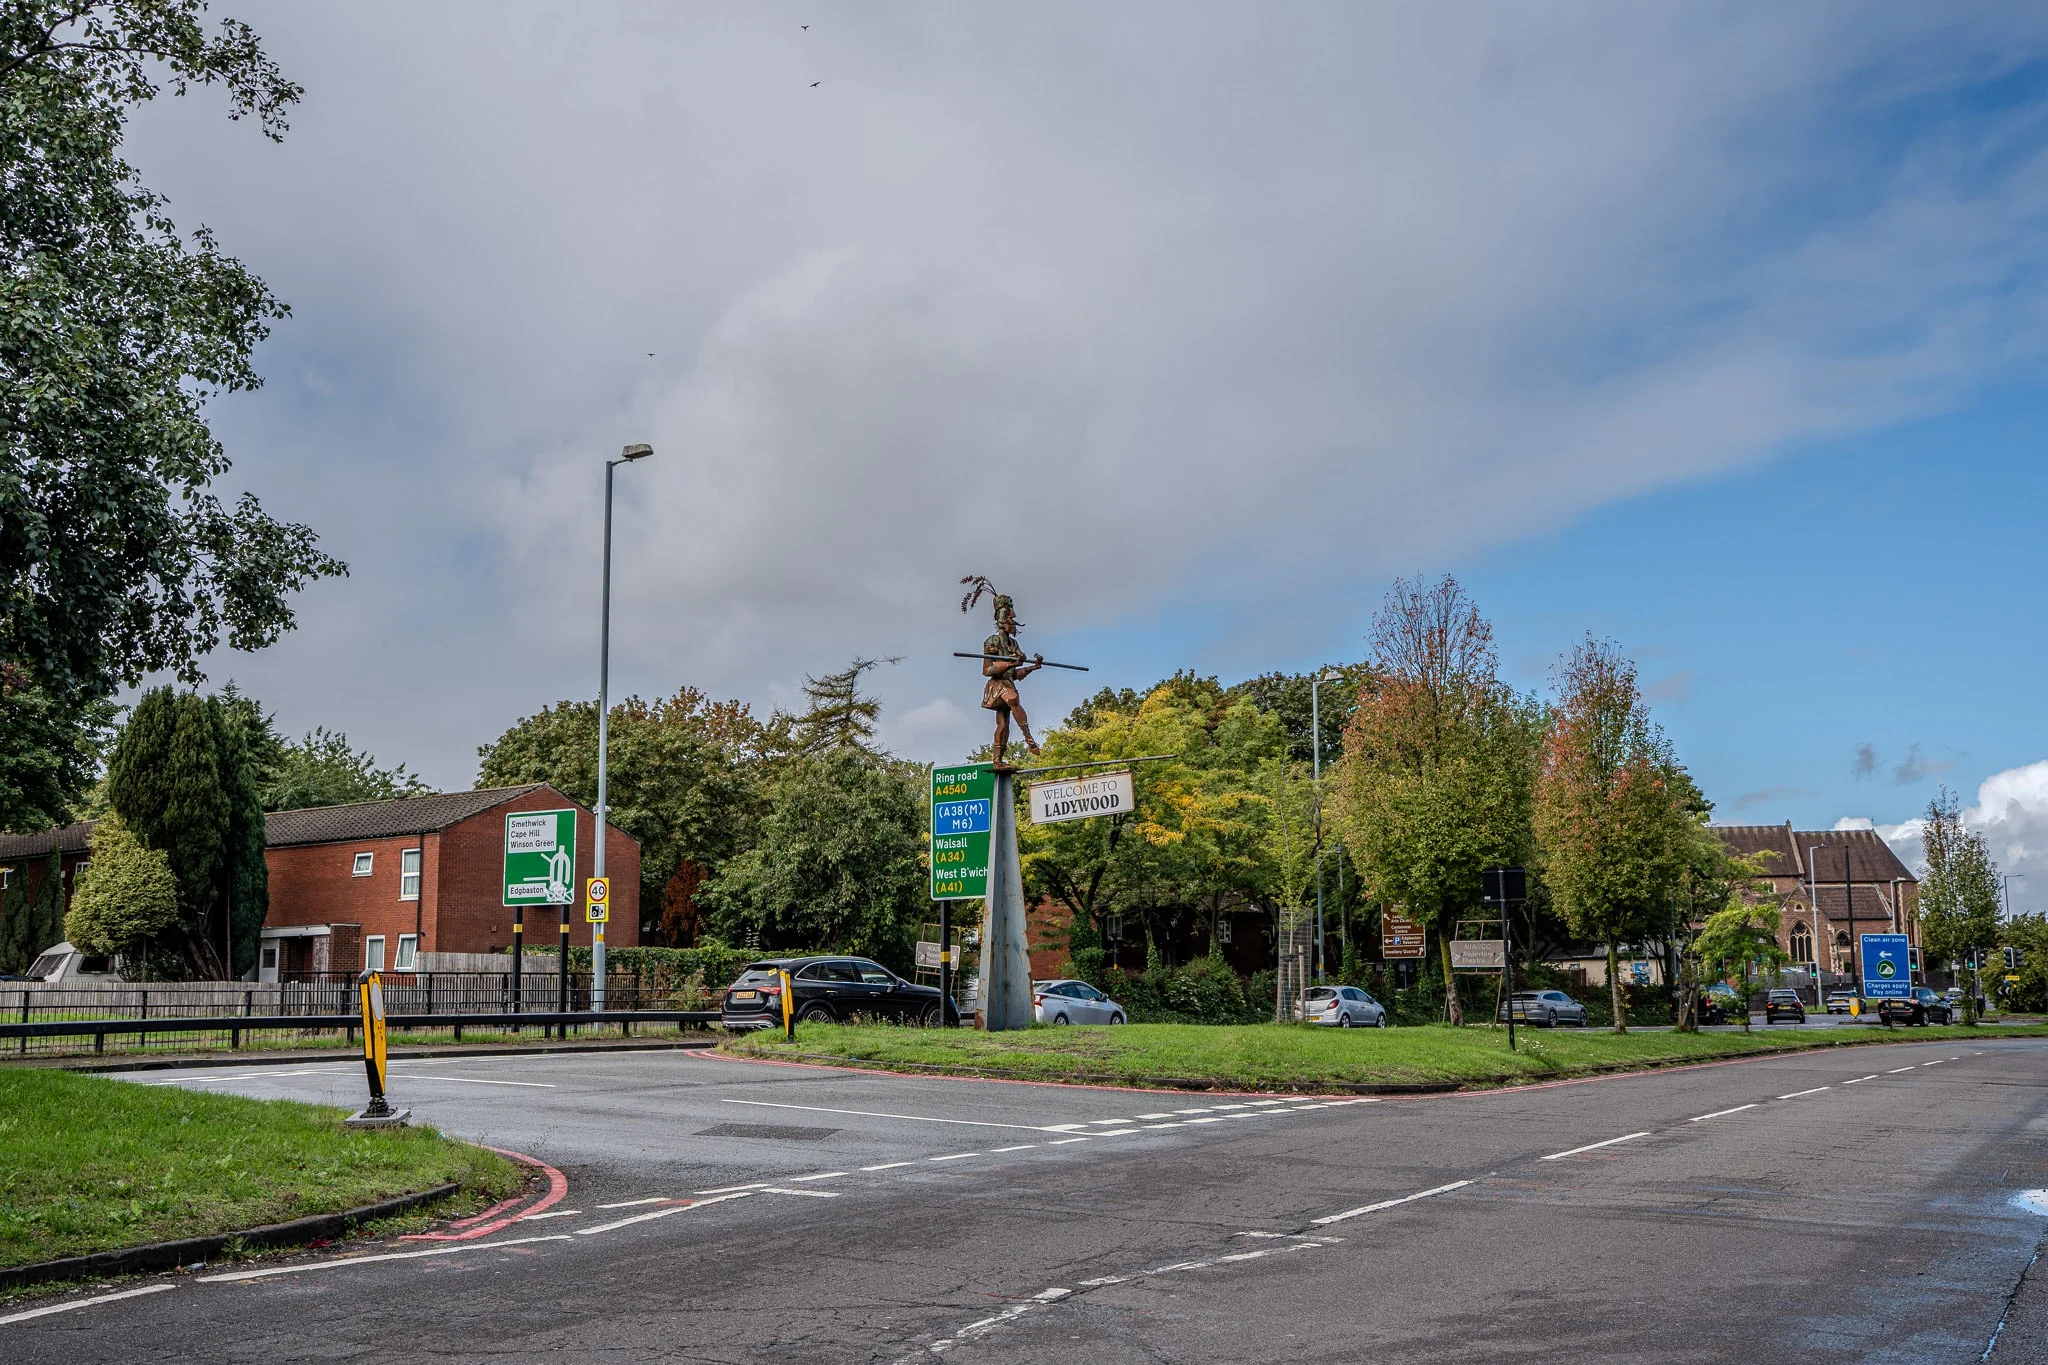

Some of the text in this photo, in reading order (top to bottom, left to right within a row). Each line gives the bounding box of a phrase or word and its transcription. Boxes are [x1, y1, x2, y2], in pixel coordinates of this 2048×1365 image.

[935, 769, 978, 785] Ring road
[935, 783, 968, 796] A4540
[1043, 780, 1118, 801] WELCOME TO
[1044, 794, 1120, 818] LADYWOOD
[511, 819, 547, 828] Smethwick
[952, 817, 973, 830] M6)
[510, 829, 540, 839] Cape Hill
[510, 839, 555, 849] Winson Green
[935, 837, 968, 850] Walsall
[935, 850, 965, 864] (A34)
[935, 868, 958, 880] West
[510, 886, 544, 896] Edgbaston
[591, 886, 605, 895] 40
[935, 880, 963, 894] (A41)
